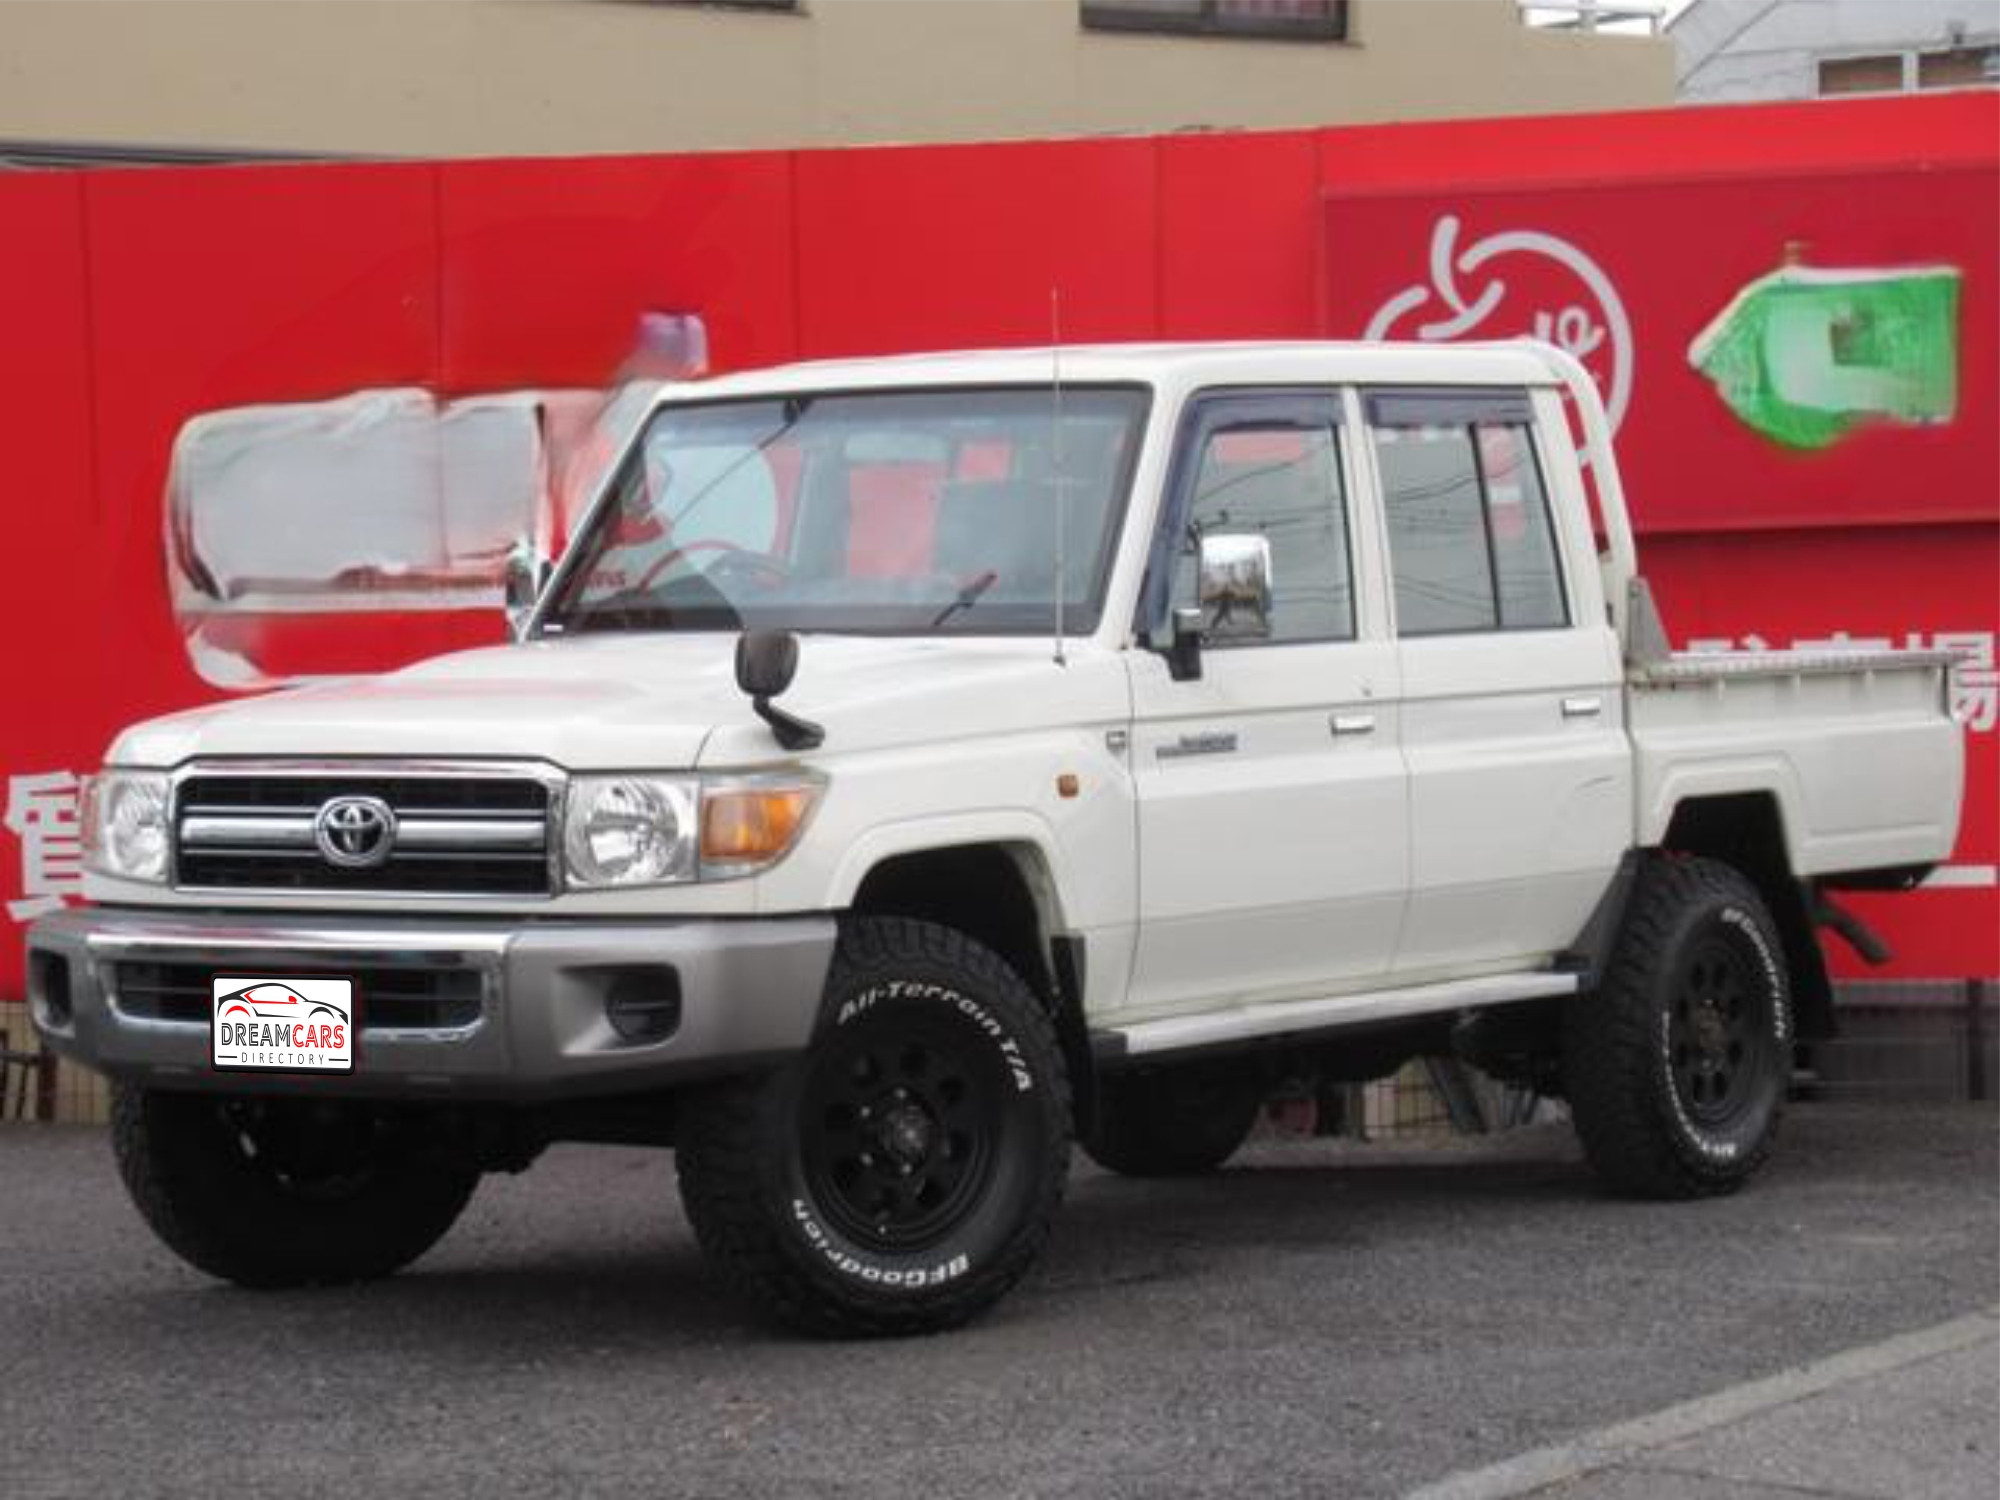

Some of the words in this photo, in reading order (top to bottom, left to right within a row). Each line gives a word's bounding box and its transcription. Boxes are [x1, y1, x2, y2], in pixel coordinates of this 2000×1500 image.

[838, 981, 1001, 1036] All-Terrain
[1001, 1037, 1033, 1091] T/A
[793, 1199, 970, 1288] BFGoodrich
